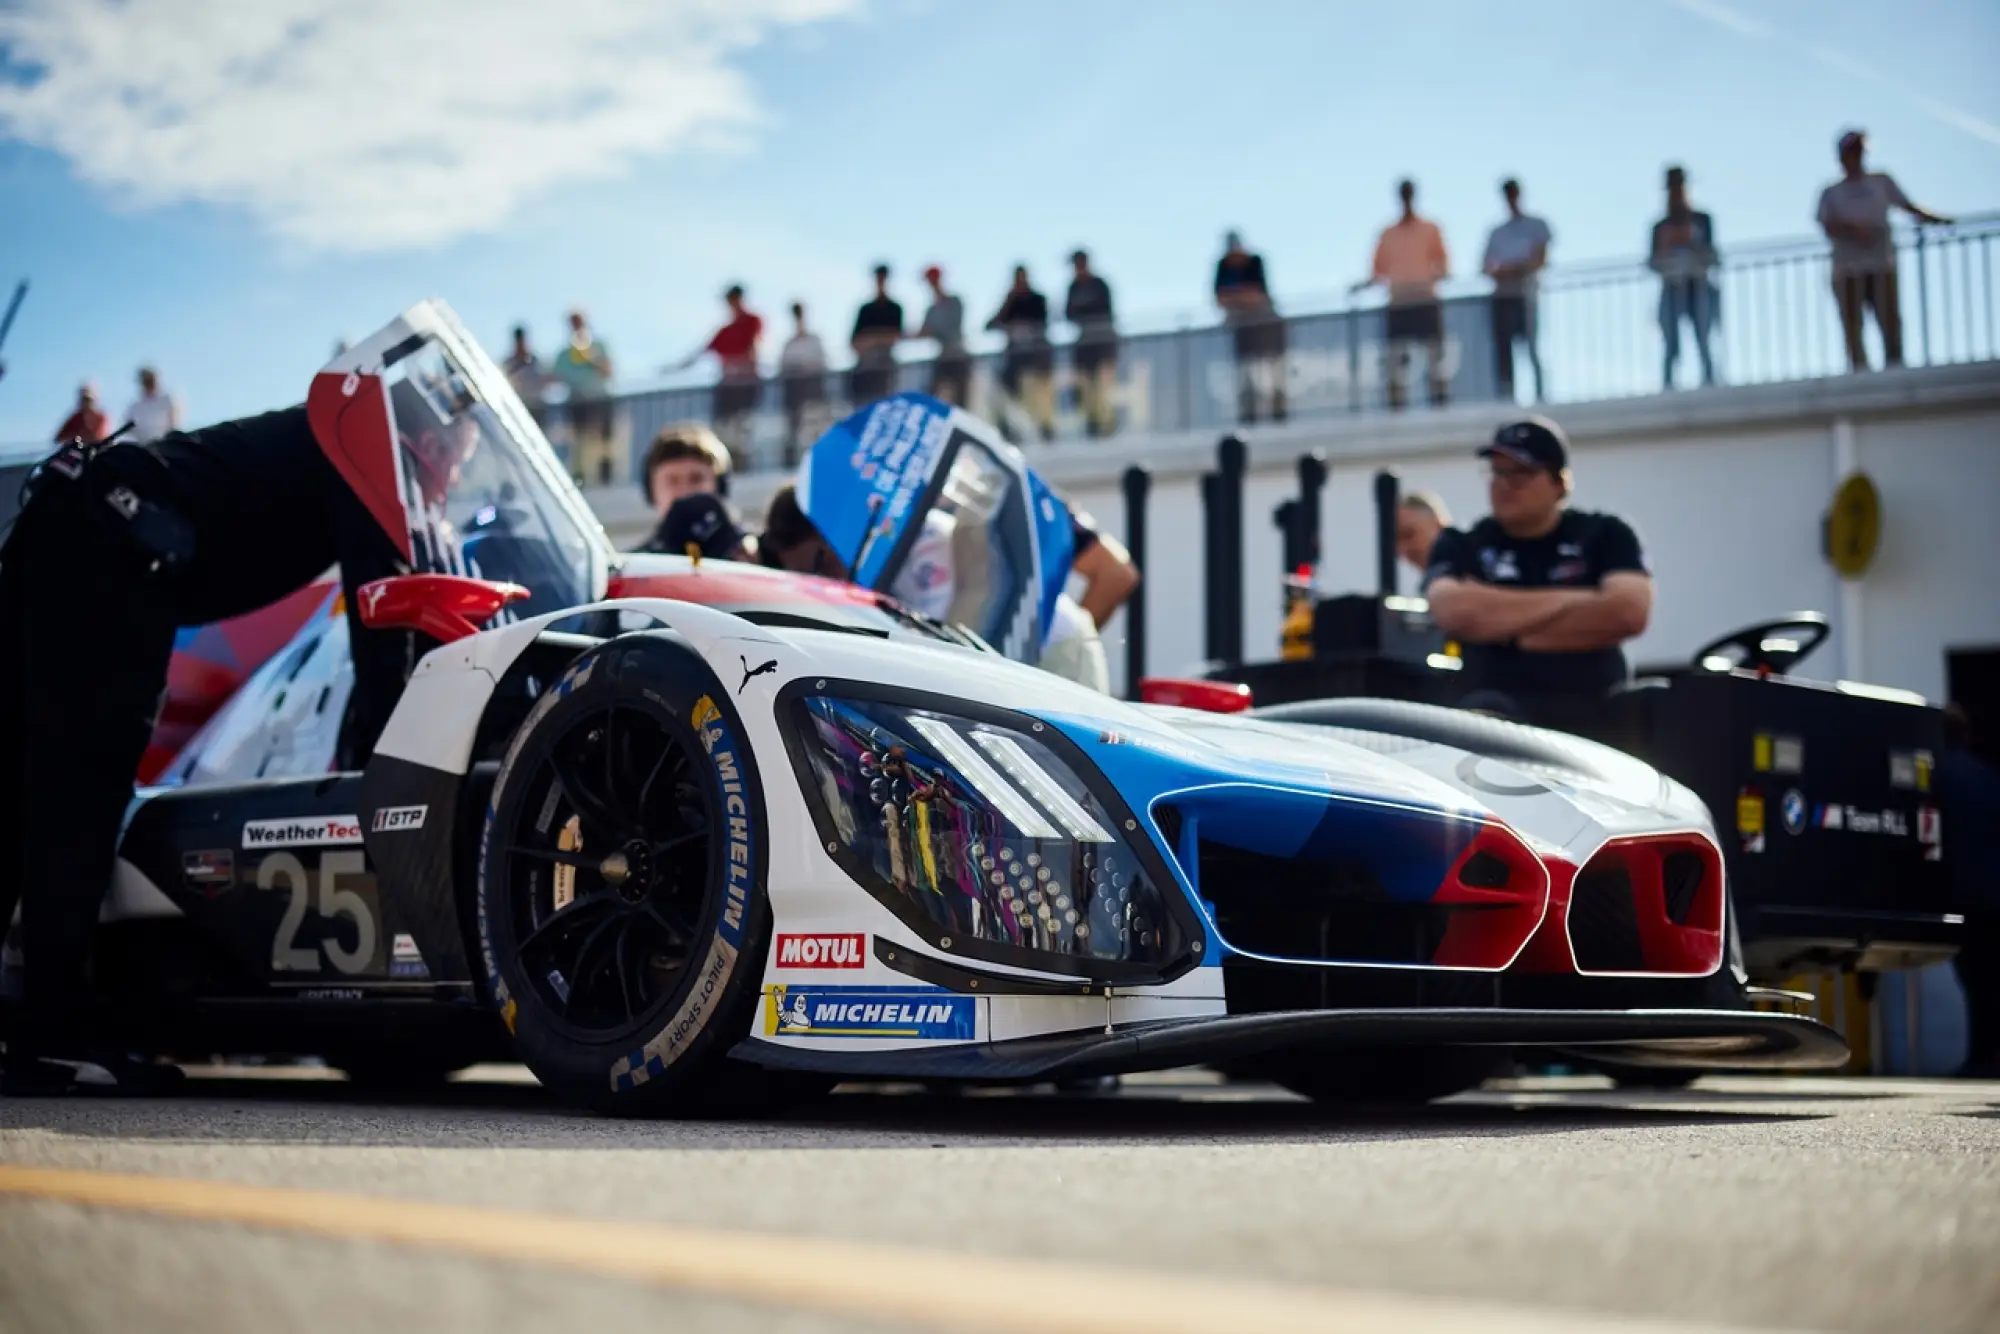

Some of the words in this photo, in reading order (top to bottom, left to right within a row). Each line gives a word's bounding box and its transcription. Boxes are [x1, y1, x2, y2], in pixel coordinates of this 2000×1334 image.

[389, 810, 422, 826] GTP
[1845, 805, 1879, 832] Team
[247, 822, 360, 843] WeatherTec
[713, 750, 748, 931] MICHELIN
[256, 851, 376, 976] 25
[780, 938, 861, 963] MOTUL
[700, 954, 726, 1005] PILOT
[668, 1002, 701, 1050] SPORT
[813, 1003, 953, 1024] MICHELIN
